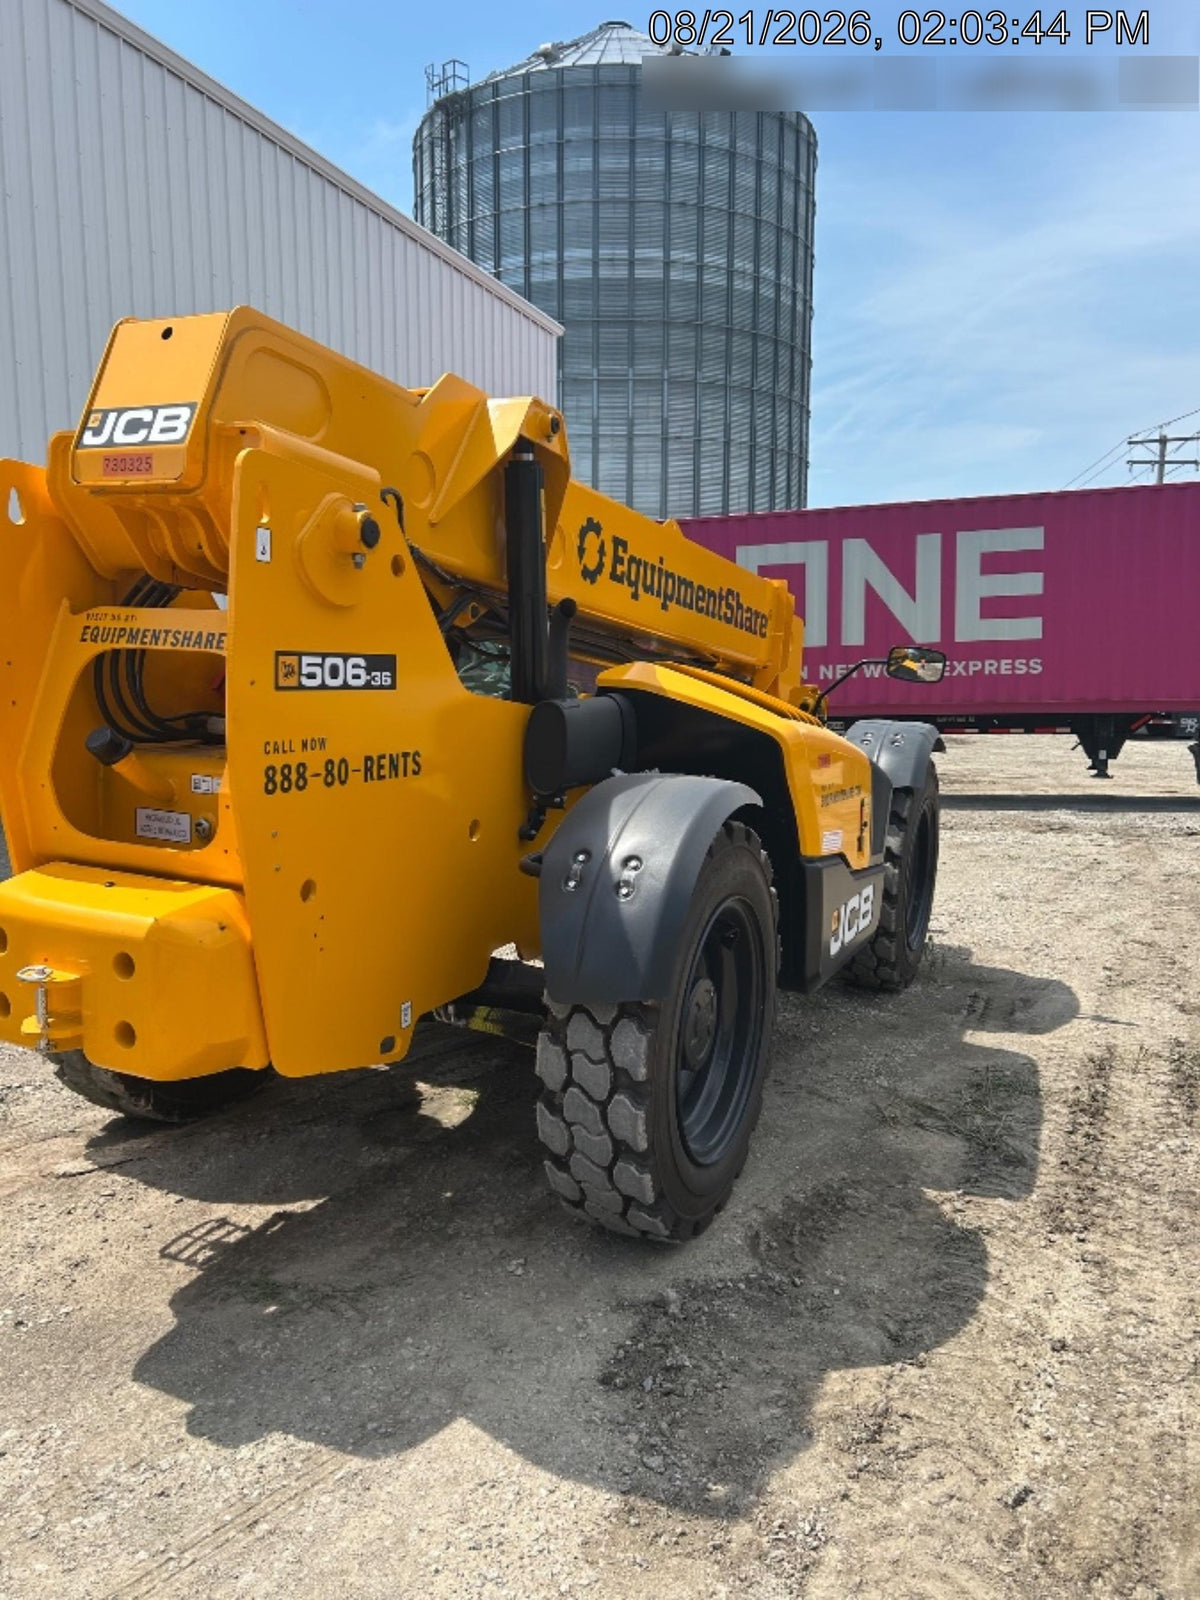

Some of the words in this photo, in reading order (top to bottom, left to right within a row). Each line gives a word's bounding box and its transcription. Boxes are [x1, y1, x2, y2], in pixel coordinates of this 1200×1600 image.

[83, 406, 191, 446] JCB
[609, 535, 769, 639] EquipmentShare
[735, 526, 1045, 648] ONE
[80, 625, 227, 650] EQUIPMENTSHARE
[819, 663, 892, 680] NETW
[264, 739, 295, 755] CALL
[301, 737, 327, 752] NOW
[264, 751, 422, 795] 888-80-RENTS
[830, 884, 874, 956] JCB
